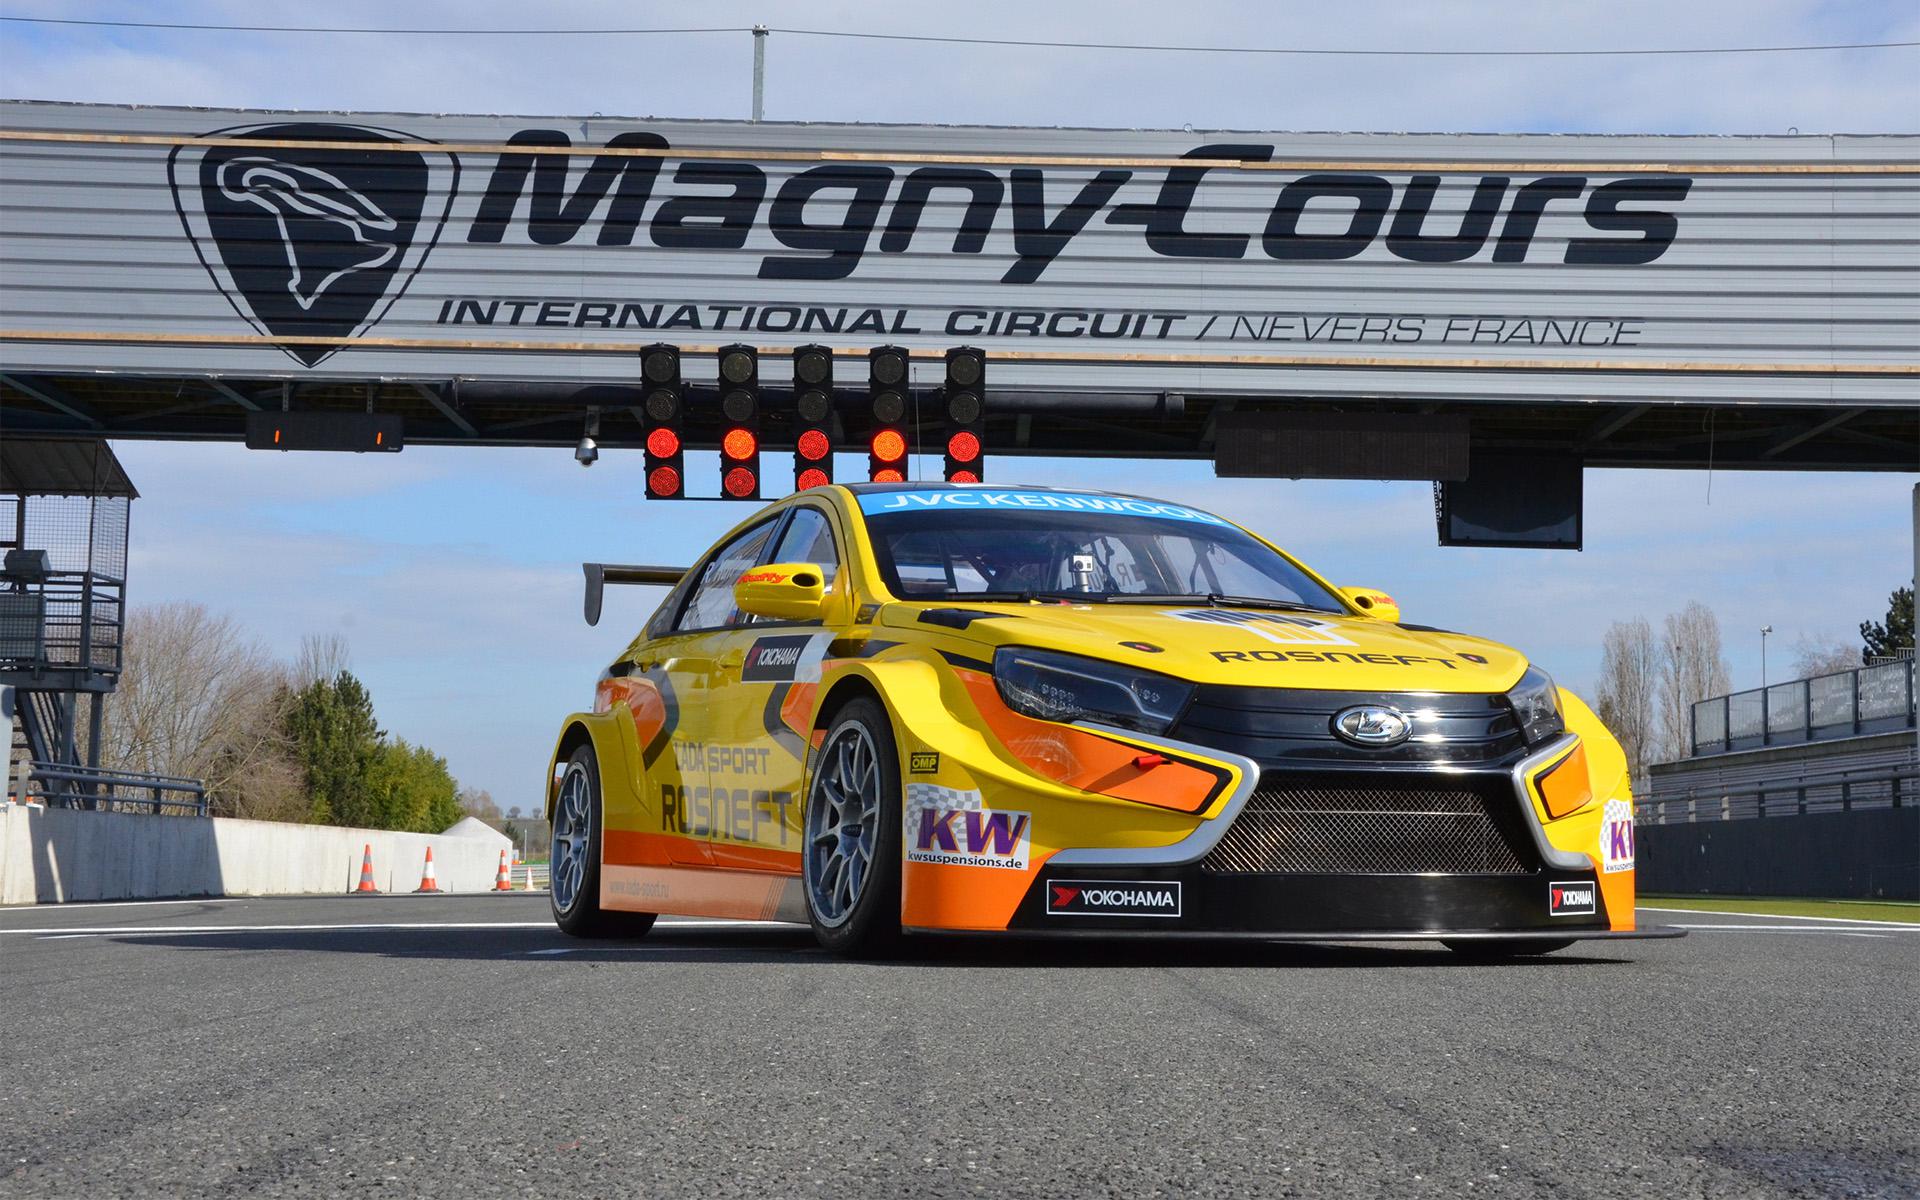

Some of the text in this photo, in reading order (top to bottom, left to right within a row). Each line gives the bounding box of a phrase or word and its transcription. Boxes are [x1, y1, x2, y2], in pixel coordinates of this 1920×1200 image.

[467, 129, 1692, 284] Magny-Cours
[437, 300, 921, 334] INTERNATIONAL
[945, 310, 1187, 339] CIRCUIT
[1230, 315, 1427, 343] NEVERS
[1441, 318, 1645, 346] FRANCE
[757, 647, 801, 667] YOKOHAMA
[1210, 650, 1458, 669] ROSNEFT
[674, 742, 770, 775] LADA SPORT
[912, 757, 937, 769] OMP
[661, 784, 793, 845] ROSNEFT
[917, 808, 1030, 857] KW
[908, 851, 1023, 869] kwsuspensions.de
[1081, 889, 1175, 907] YOKOHAMA
[1562, 890, 1592, 906] YOKOHAMA
